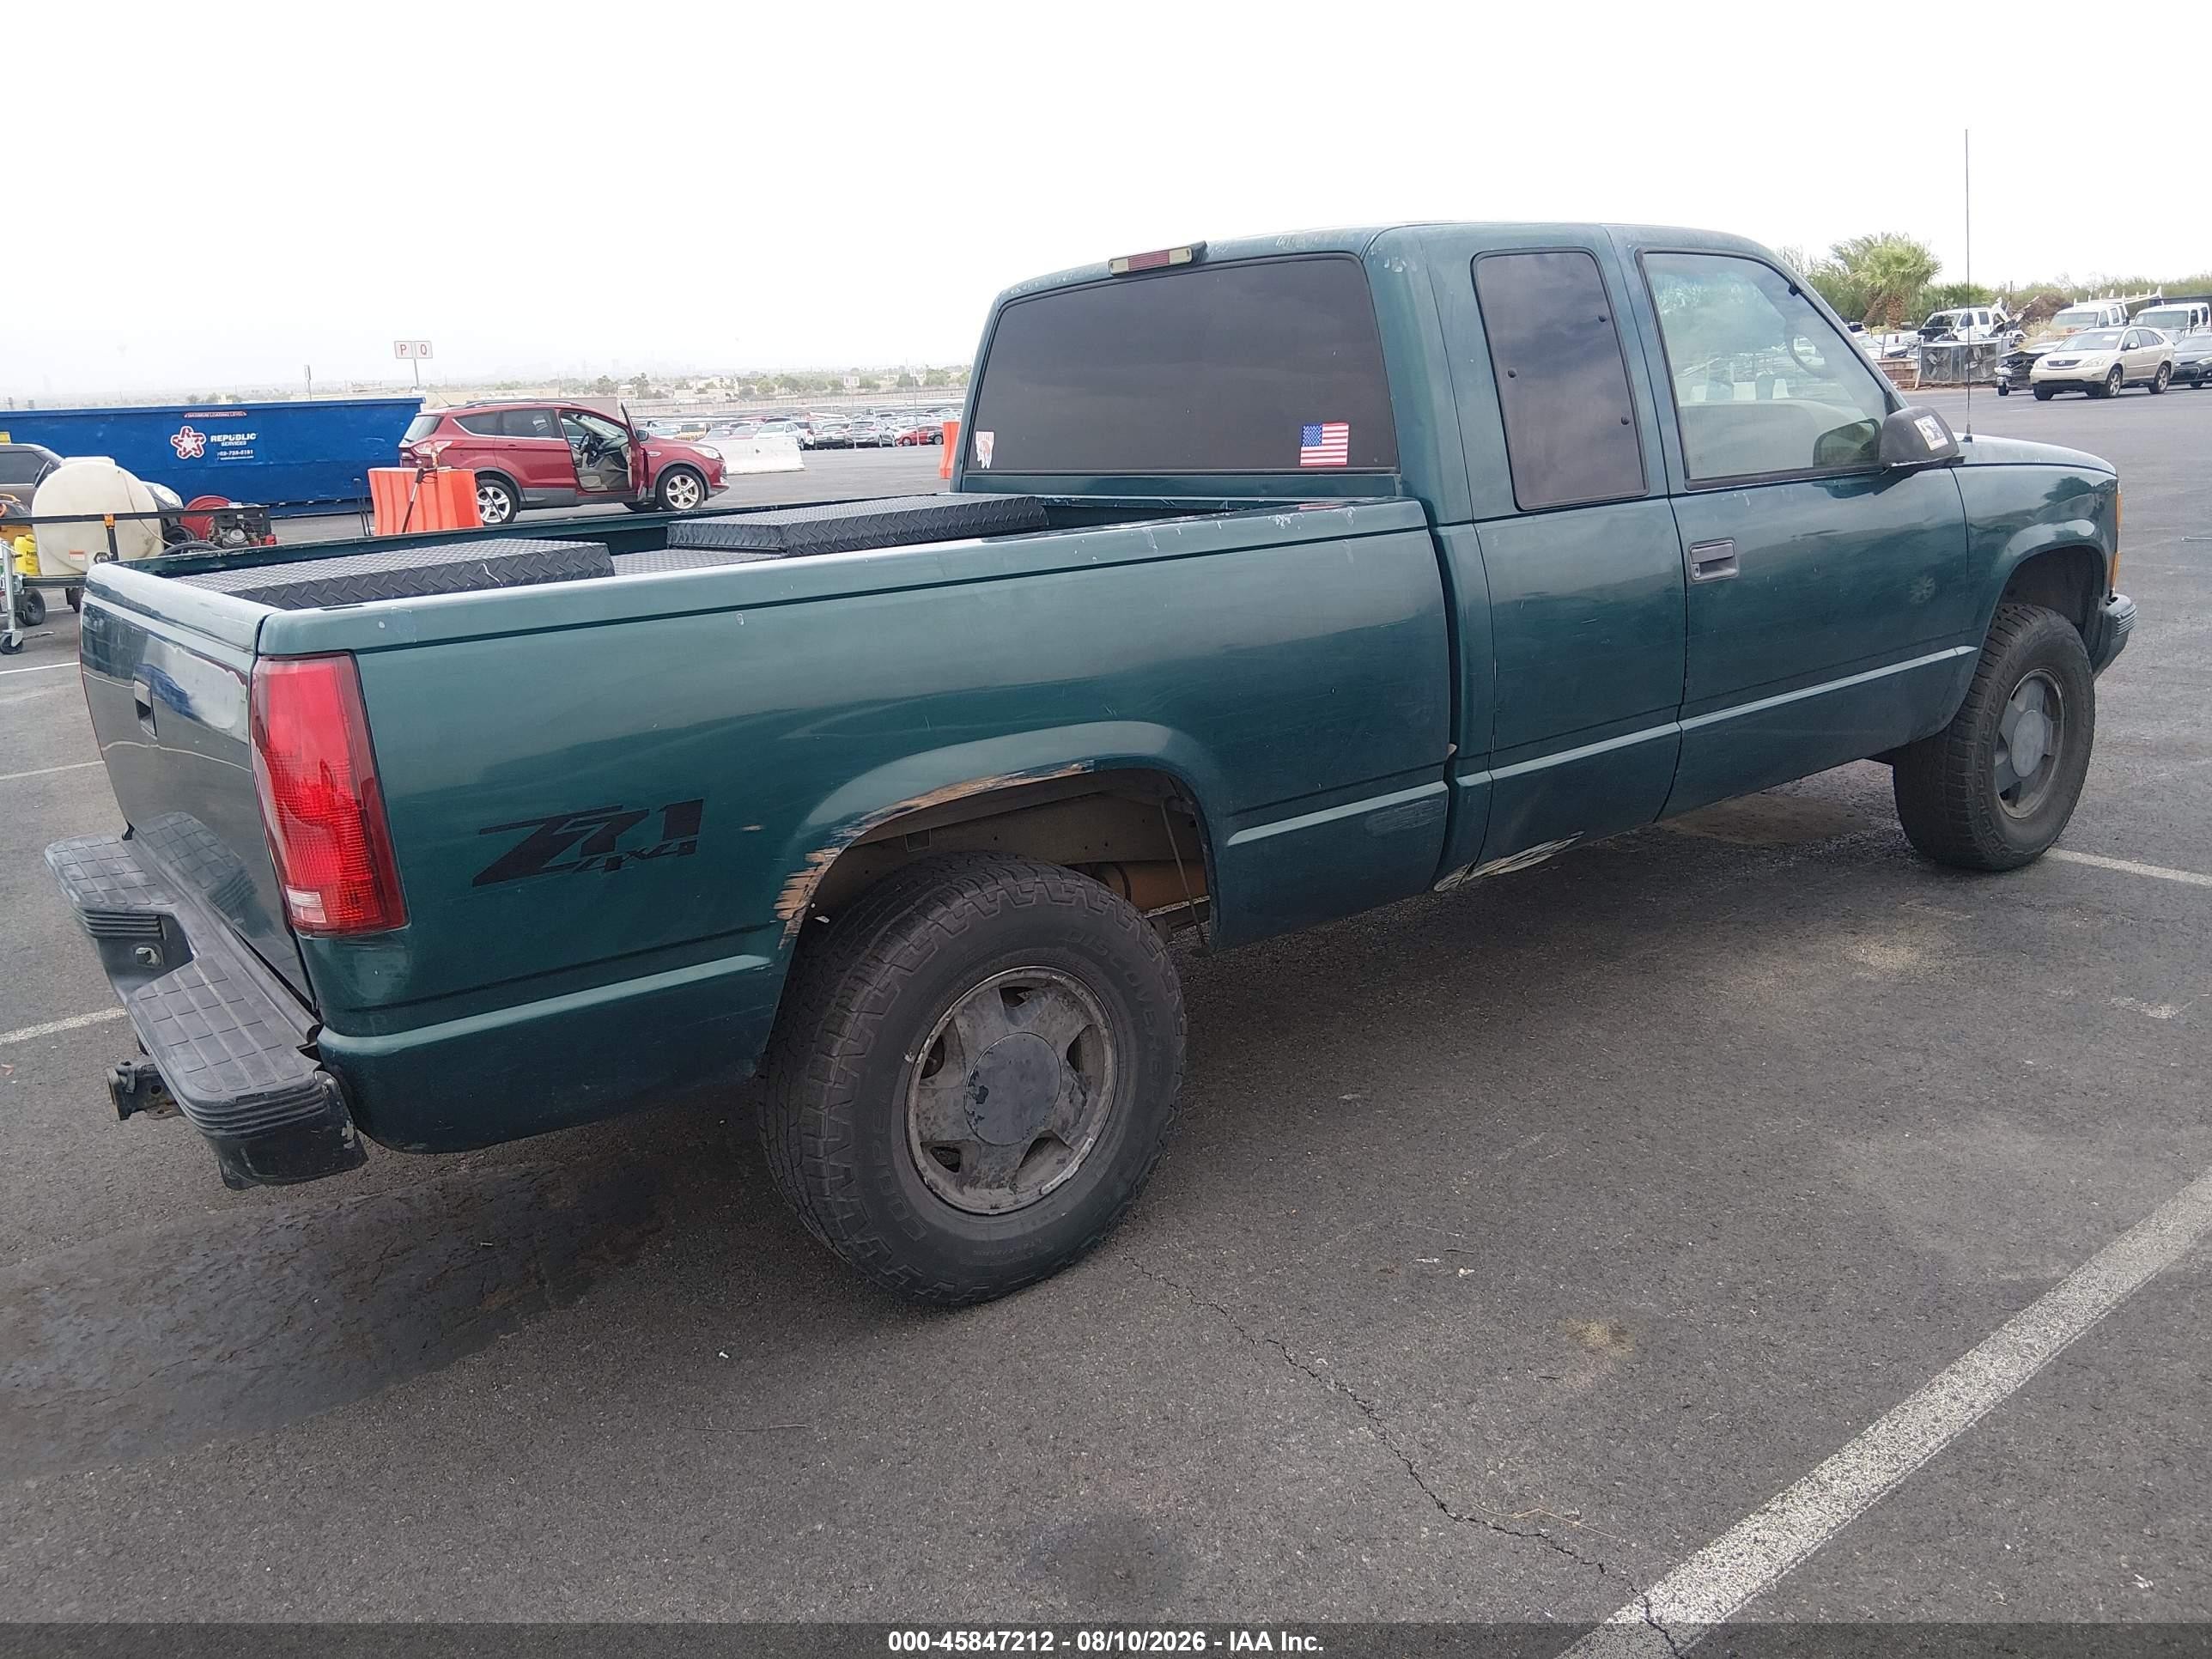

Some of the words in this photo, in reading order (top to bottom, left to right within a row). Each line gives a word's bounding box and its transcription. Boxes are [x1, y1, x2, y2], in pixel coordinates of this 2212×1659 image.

[399, 343, 407, 356] P
[210, 433, 257, 442] REPUBLIC
[472, 798, 704, 888] Z71
